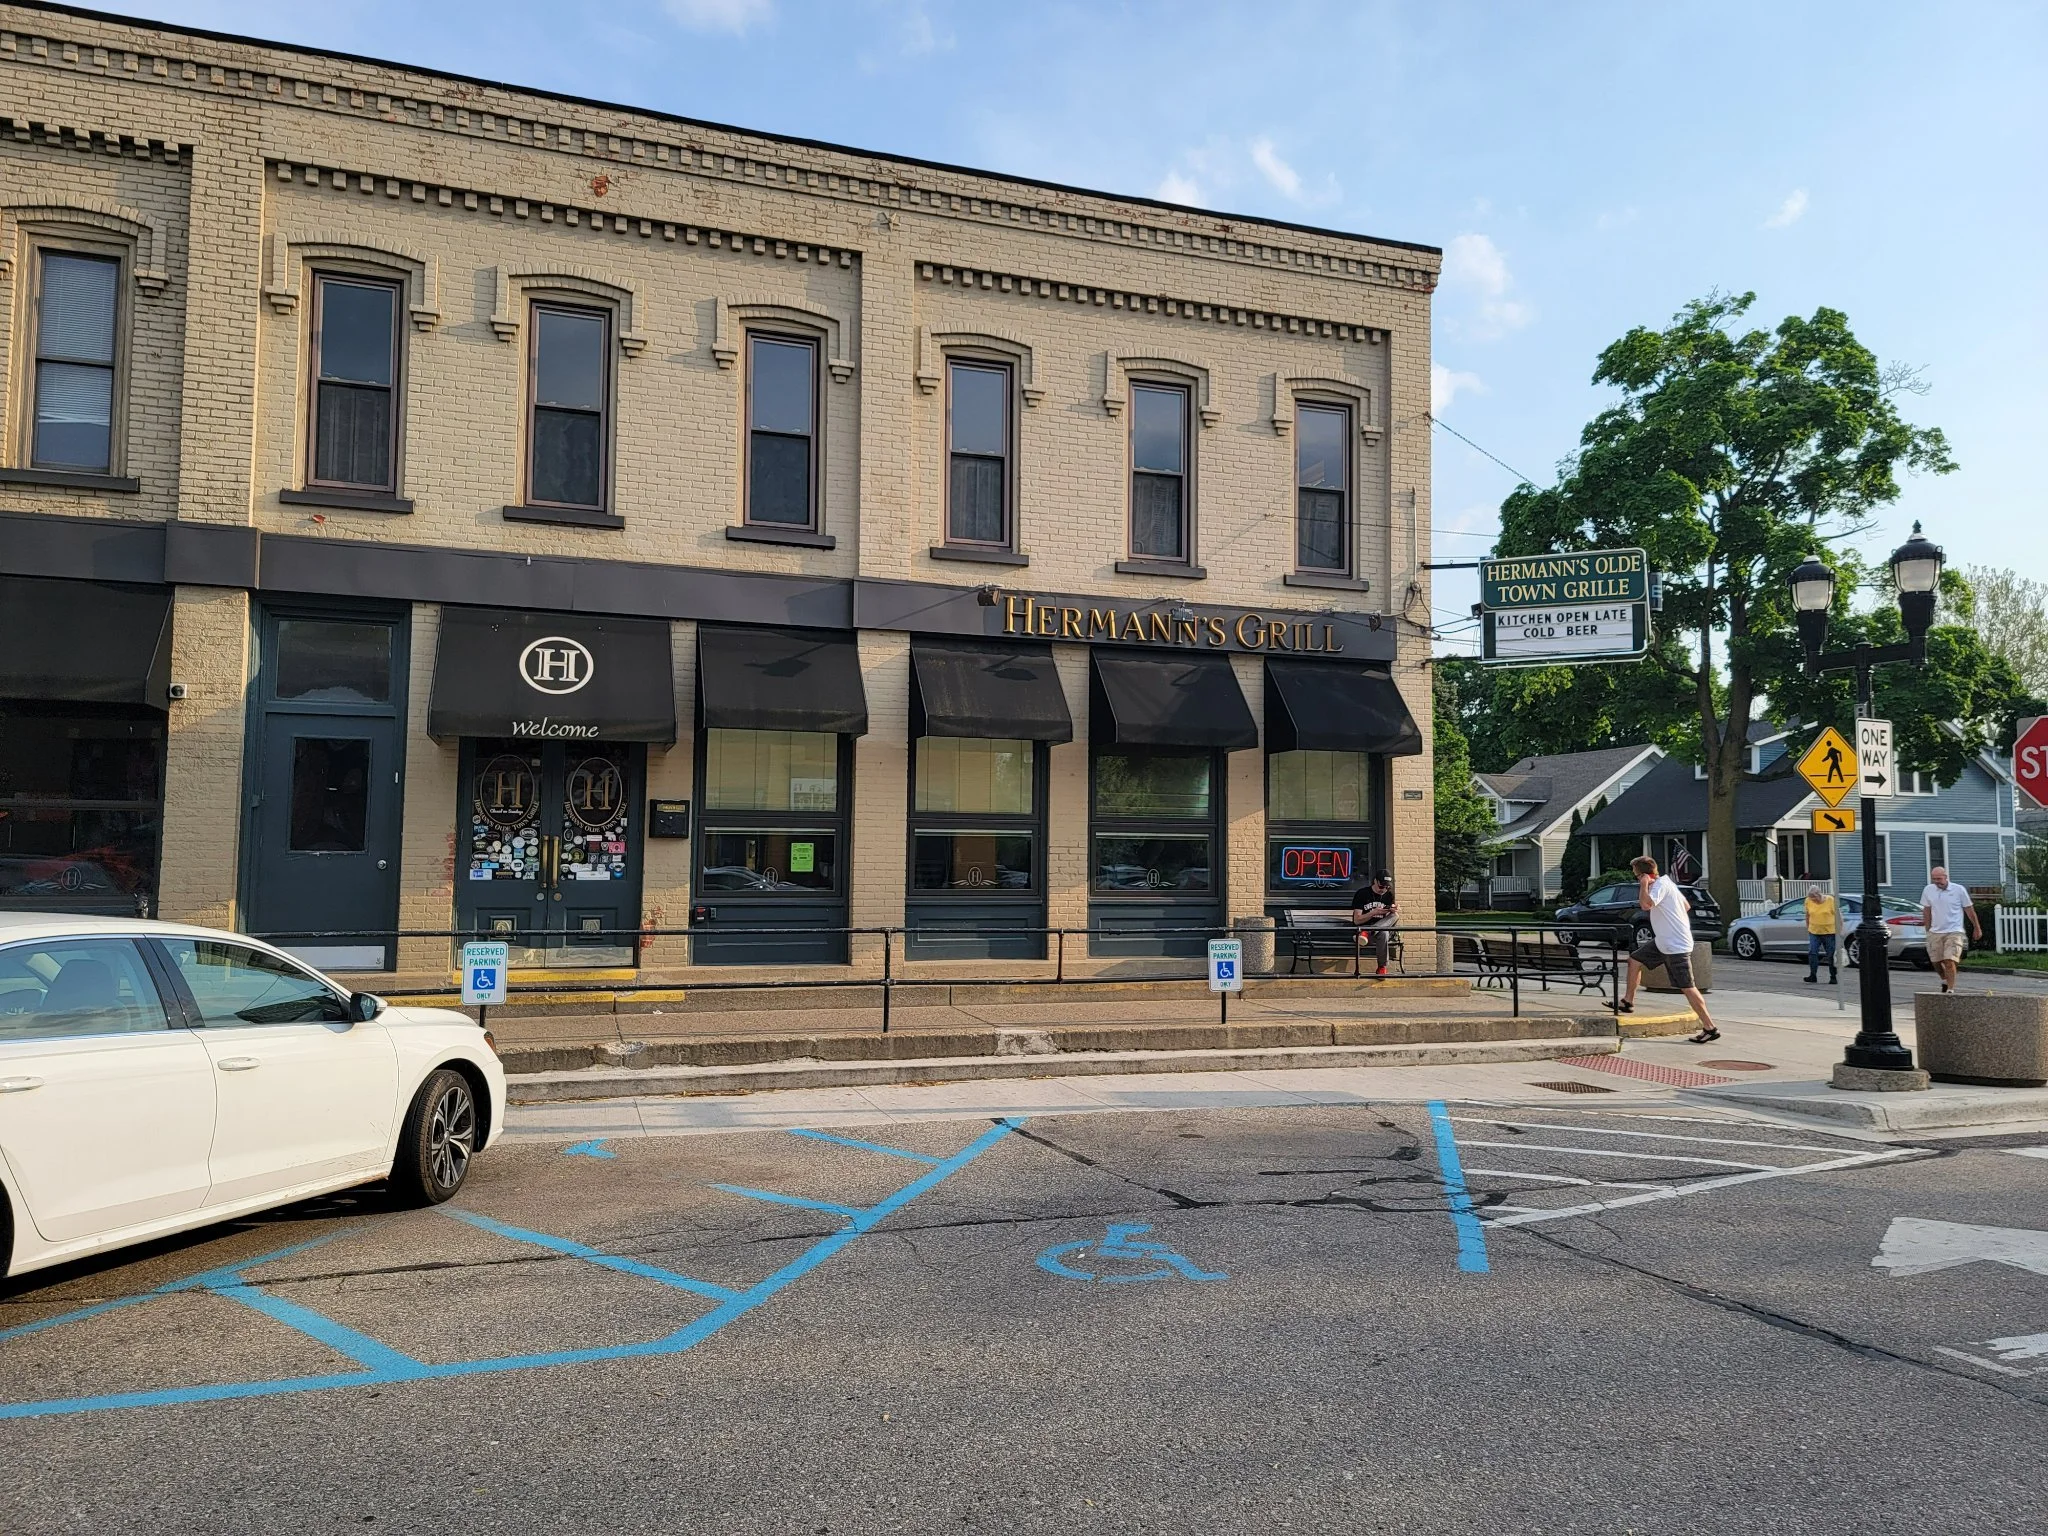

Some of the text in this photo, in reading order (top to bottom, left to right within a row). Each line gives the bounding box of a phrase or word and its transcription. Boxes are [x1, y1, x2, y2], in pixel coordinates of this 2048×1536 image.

[1487, 555, 1641, 582] HERMANN'S OLDE
[1498, 578, 1630, 602] TOWN GRILLE
[1003, 595, 1345, 652] HERMANN'S GRILL
[1498, 609, 1627, 626] KITCHEN OPEN LATE
[1523, 624, 1598, 638] COLD BEER
[533, 647, 580, 682] H
[1861, 728, 1888, 746] ONE
[1861, 749, 1888, 767] WAY
[584, 825, 601, 833] OLDE
[1284, 849, 1349, 878] OPEN
[466, 947, 505, 956] RESERVED
